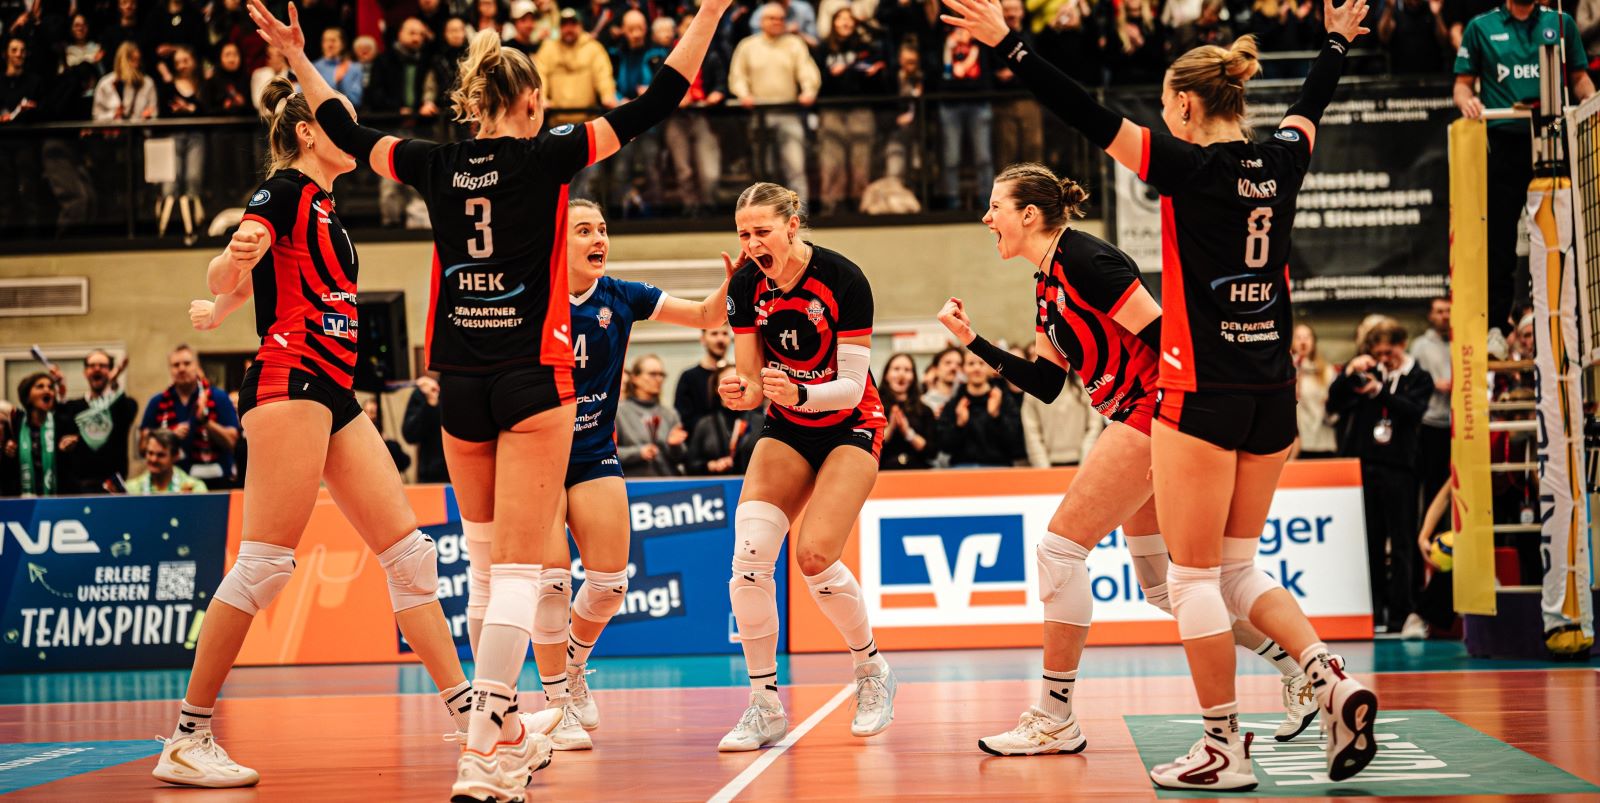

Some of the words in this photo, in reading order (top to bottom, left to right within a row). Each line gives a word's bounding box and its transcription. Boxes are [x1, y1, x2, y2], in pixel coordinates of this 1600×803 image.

[452, 170, 499, 190] KÖSTER
[465, 197, 494, 259] 3
[1245, 207, 1273, 268] 8
[458, 272, 505, 292] HEK
[1230, 283, 1272, 302] HEK
[471, 307, 516, 317] PARTNER
[461, 317, 523, 329] GESUNDHEIT
[1461, 344, 1475, 441] Hamburg
[631, 494, 725, 531] Bank:
[95, 565, 152, 584] ERLEBE
[77, 583, 150, 602] UNSEREN
[20, 603, 206, 650] TEAMSPIRIT!
[475, 690, 488, 712] nine
